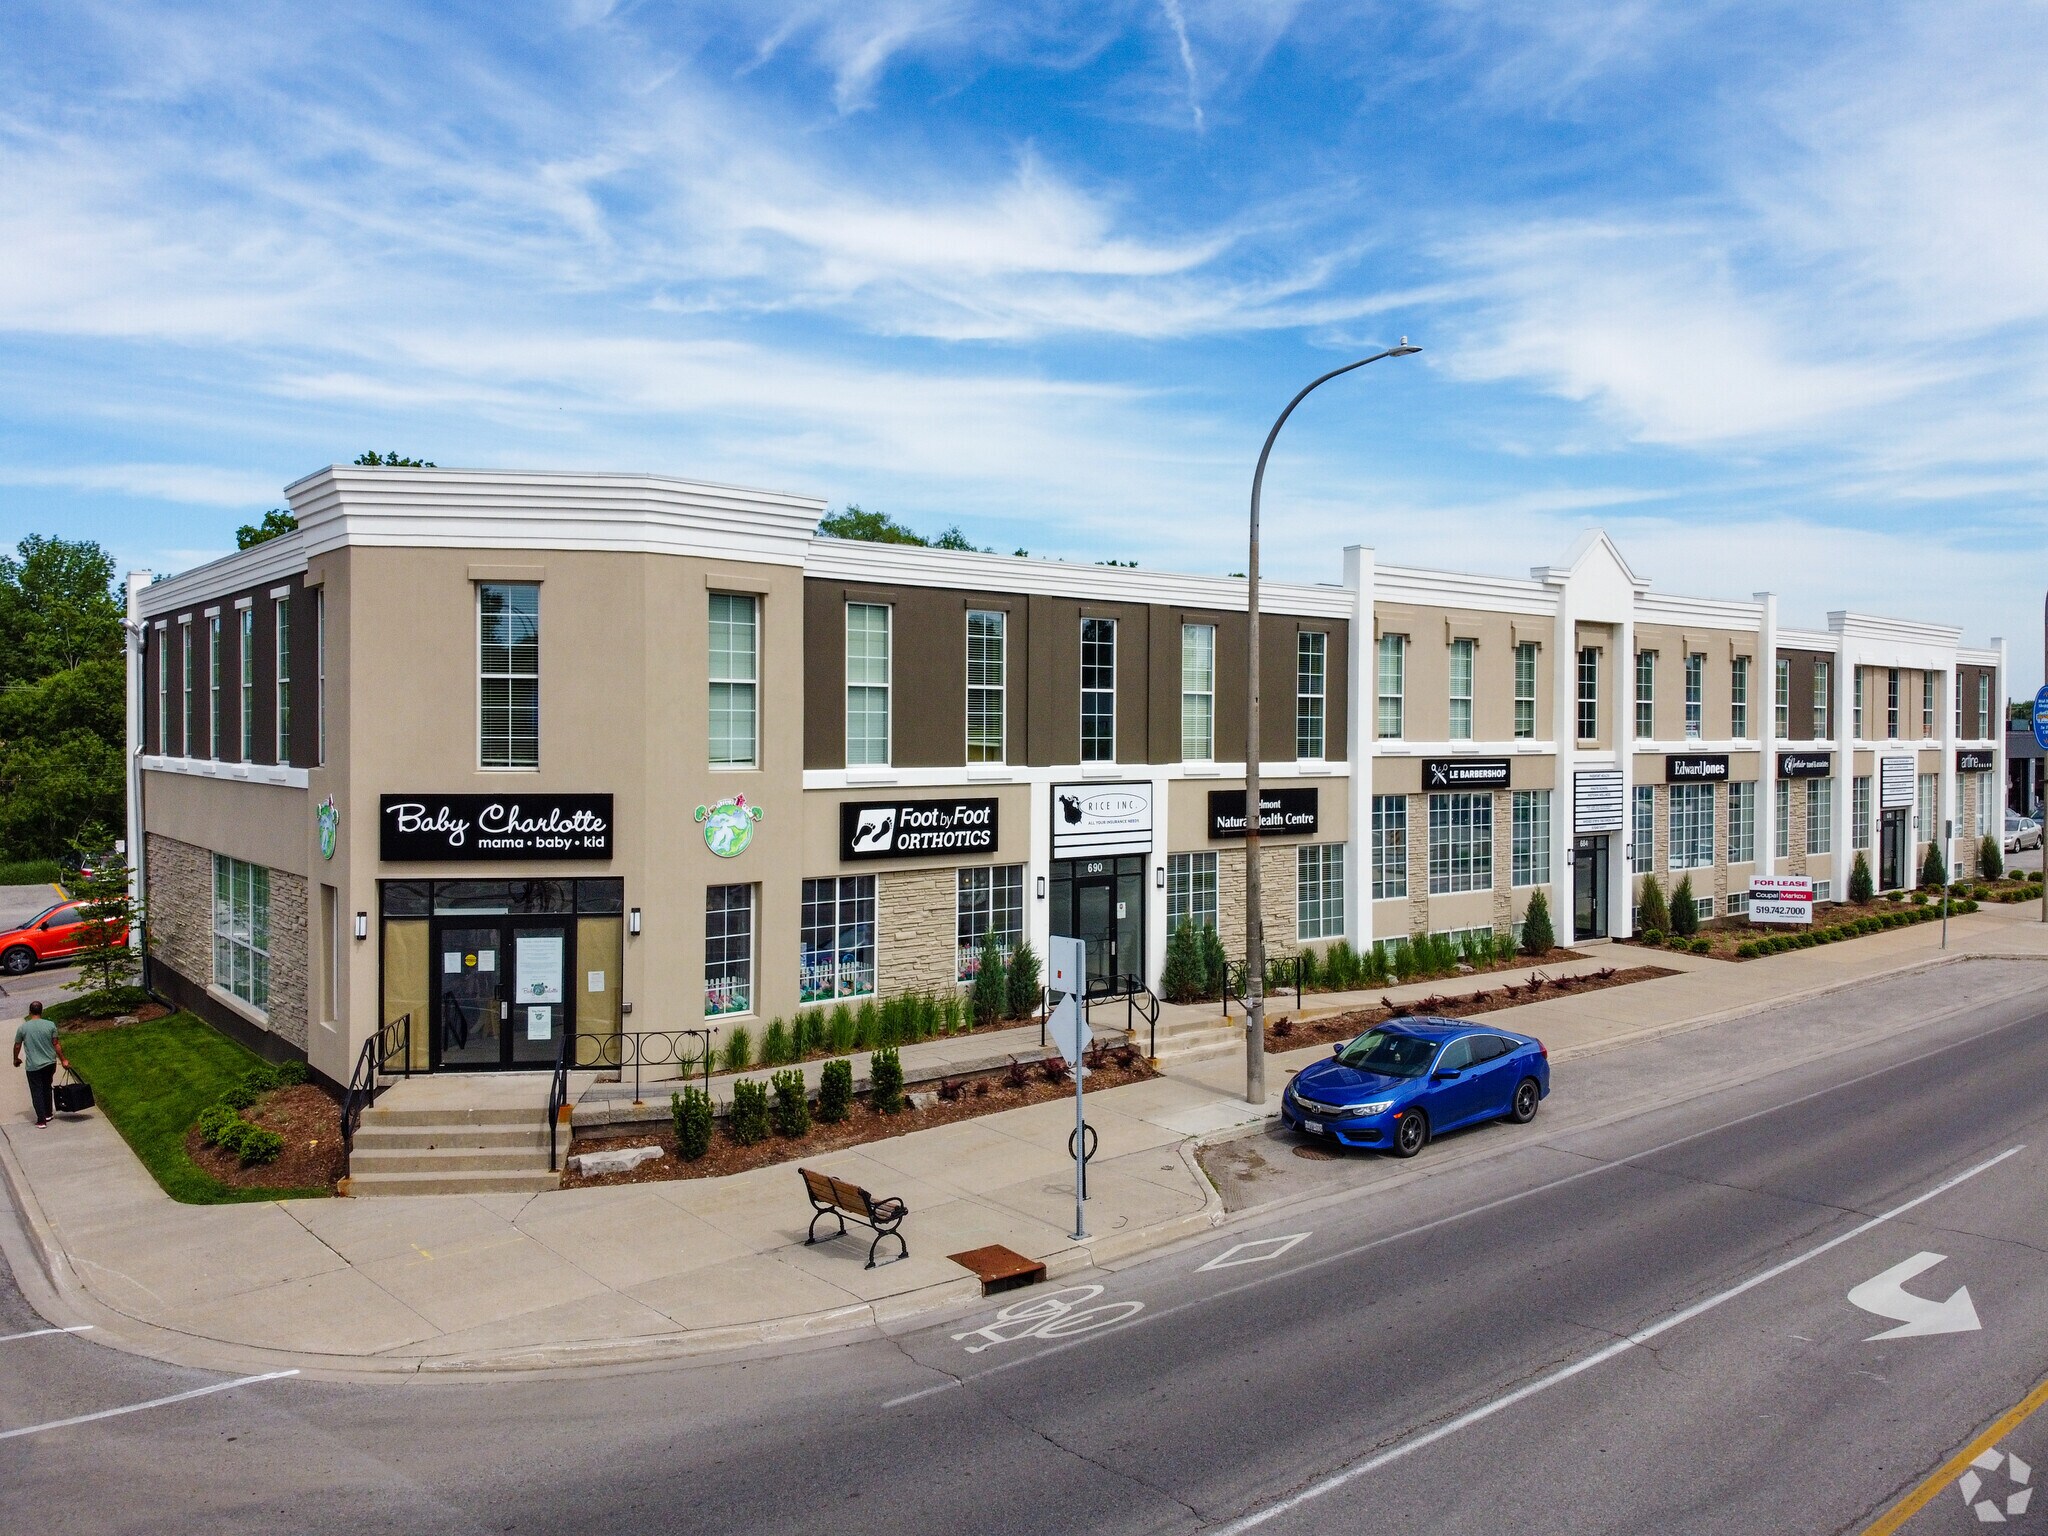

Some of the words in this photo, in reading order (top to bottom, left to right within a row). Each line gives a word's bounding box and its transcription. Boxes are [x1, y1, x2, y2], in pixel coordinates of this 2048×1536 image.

[1449, 770, 1459, 779] LE
[1459, 769, 1507, 779] BARBERSHOP
[1088, 801, 1110, 811] RICE
[1117, 800, 1138, 810] INC.
[900, 807, 939, 828] Foot
[939, 812, 954, 828] by
[953, 806, 991, 825] Foot
[1217, 816, 1247, 828] Natura
[1285, 813, 1314, 825] Centre
[387, 803, 470, 846] Baby
[479, 803, 607, 833] Charlotte
[478, 838, 524, 848] mama
[535, 836, 573, 850] baby
[583, 836, 605, 847] kid
[897, 830, 991, 850] ORTHOTICS
[1088, 863, 1103, 873] 690
[1756, 906, 1806, 915] 519.742.7000
